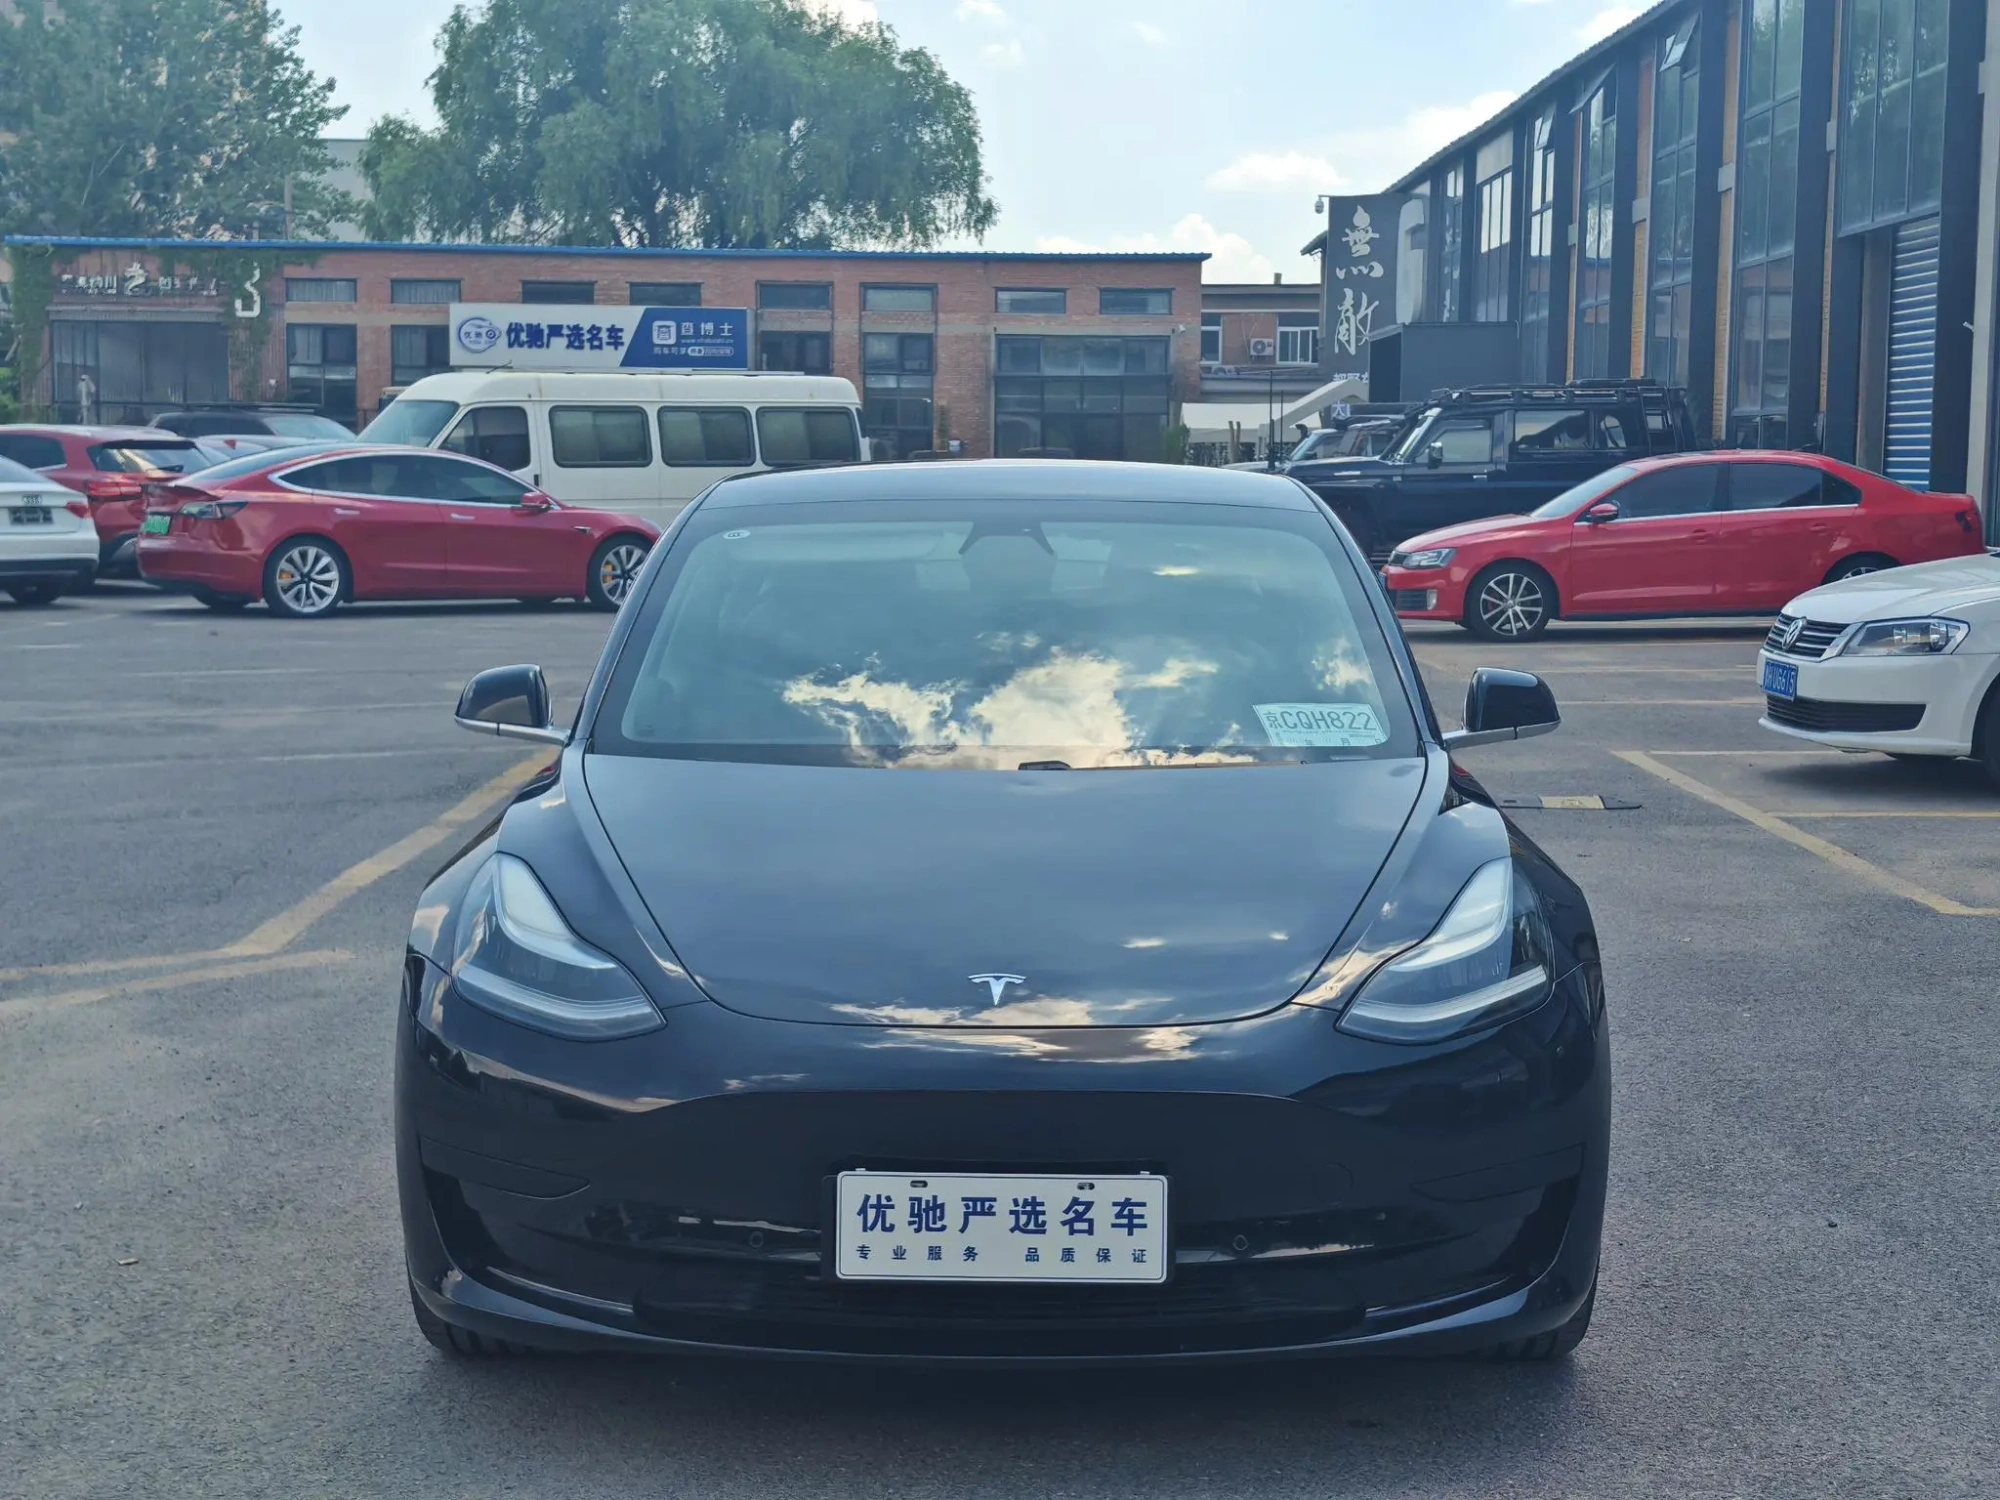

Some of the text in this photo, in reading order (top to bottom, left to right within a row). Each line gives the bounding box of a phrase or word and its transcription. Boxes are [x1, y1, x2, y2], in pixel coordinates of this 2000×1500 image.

[506, 322, 625, 350] 优驰严选名车
[680, 322, 734, 336] 查博士
[1263, 711, 1377, 730] 京CQH822
[857, 1194, 1148, 1236] 优驰严选名车
[856, 1244, 1147, 1264] 专业服务 品质保证
